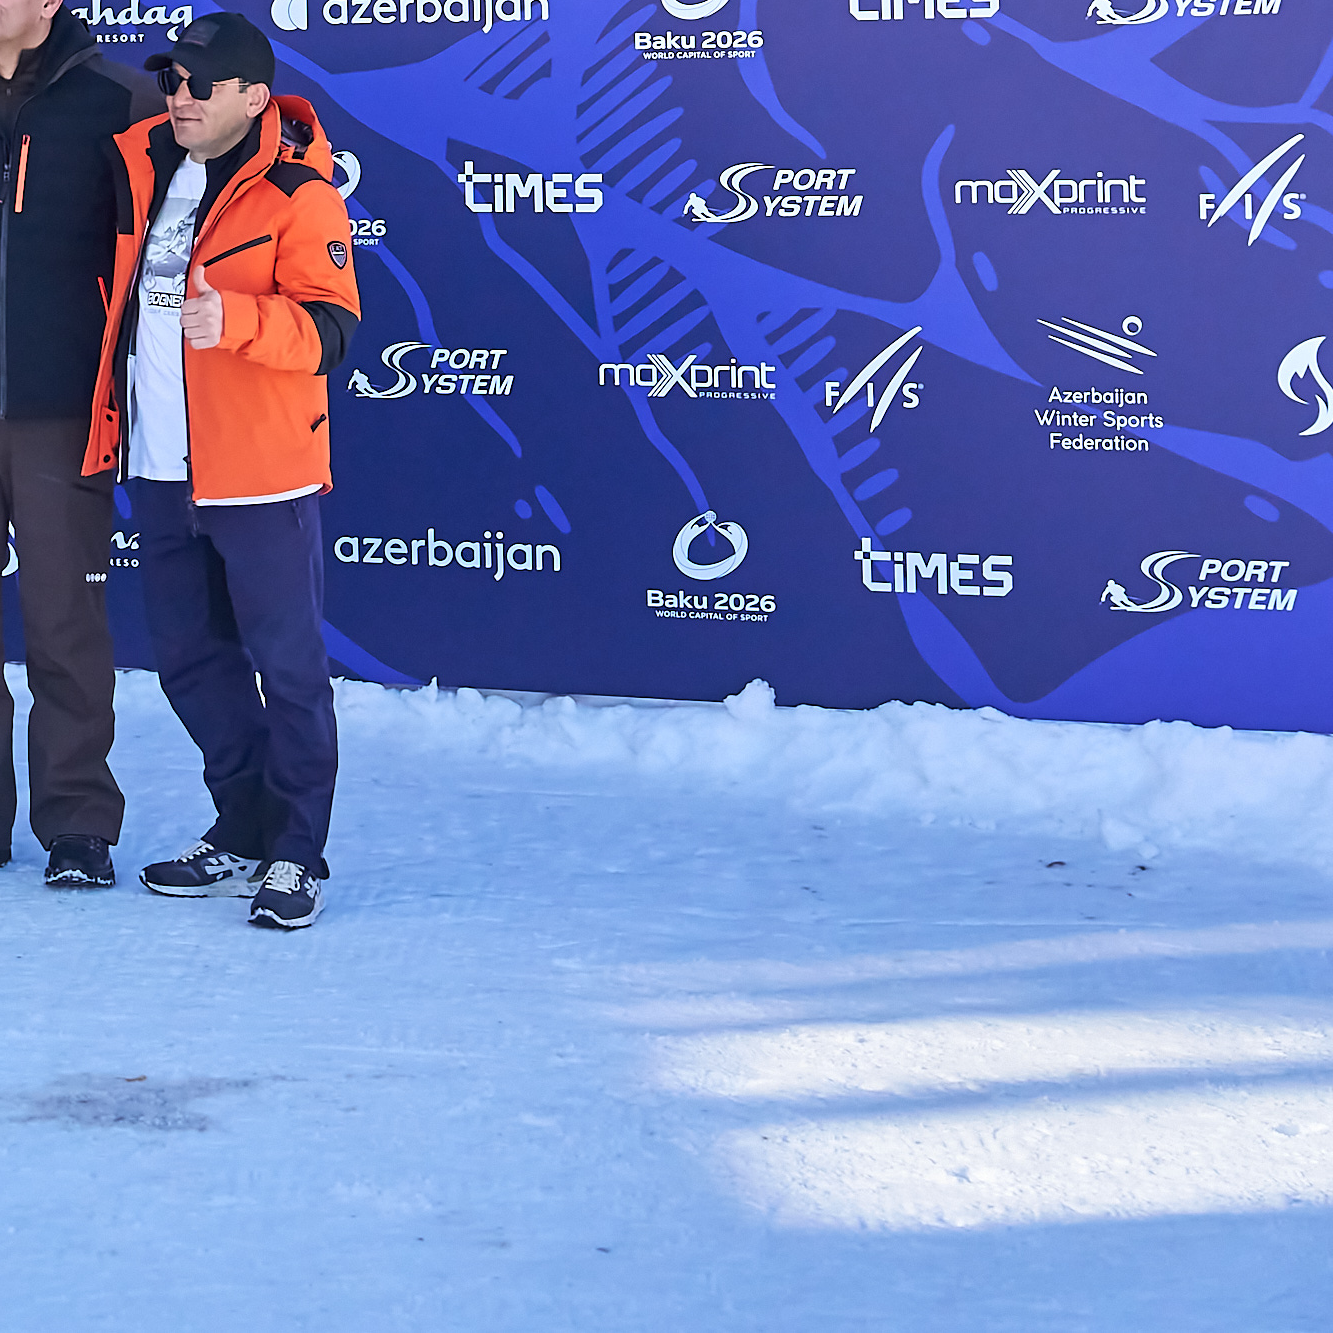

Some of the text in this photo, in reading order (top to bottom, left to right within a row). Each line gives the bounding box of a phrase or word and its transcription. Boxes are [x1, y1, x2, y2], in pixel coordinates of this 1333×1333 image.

[96, 33, 145, 43] RESORT
[634, 31, 764, 50] Baku 2026
[643, 50, 756, 59] WORLD CAPITAL OF SPORT
[1063, 206, 1148, 216] PROGRESSIVE
[348, 218, 387, 237] 026
[353, 238, 379, 246] SPORT
[148, 292, 185, 307] BOGNE
[699, 391, 777, 400] PROGRESSIVE
[1048, 386, 1148, 408] Azerbaijan
[1034, 409, 1164, 431] Winter Sports
[1049, 432, 1149, 452] Federation
[334, 528, 561, 582] azerbaijan
[646, 589, 777, 613] Baku 2026
[655, 609, 769, 623] WORLD CAPITAL OF SPORT
